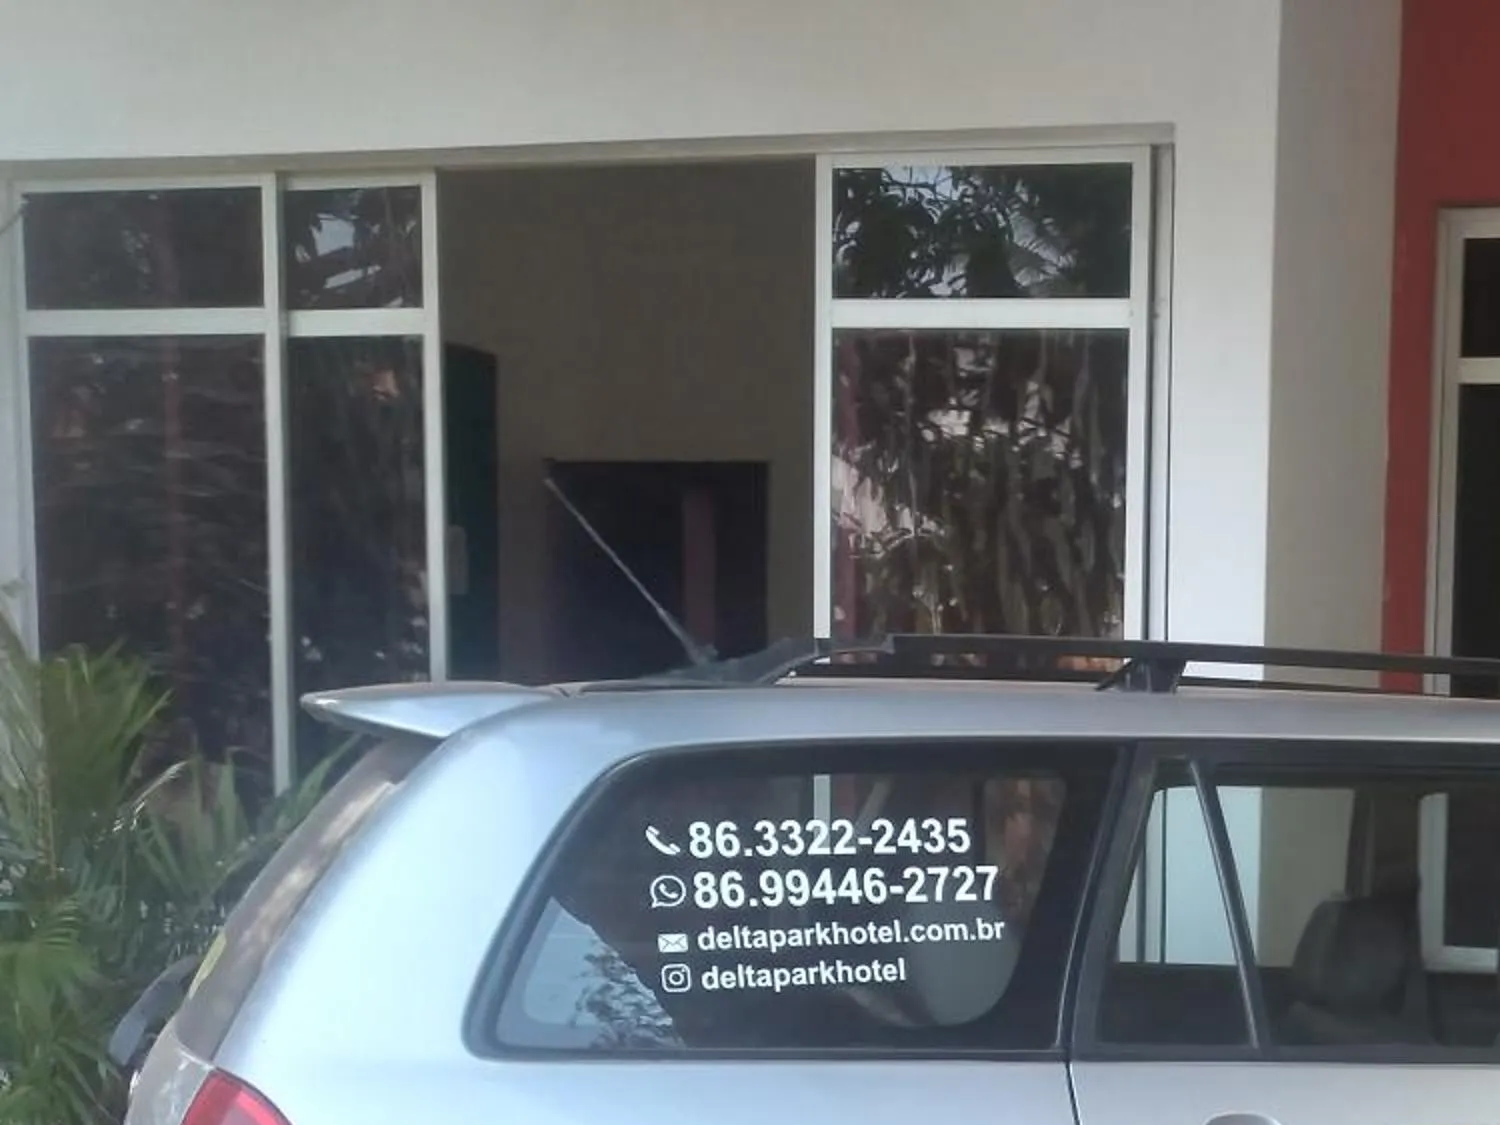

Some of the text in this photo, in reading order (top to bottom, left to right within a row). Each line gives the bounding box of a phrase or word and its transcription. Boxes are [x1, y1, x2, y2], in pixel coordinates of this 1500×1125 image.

[688, 817, 972, 859] 86.3322-2435
[693, 864, 999, 910] 86.99446-2727
[697, 918, 1006, 954] deltaparkhotel.com.br
[700, 957, 907, 993] deltaparkhotel
